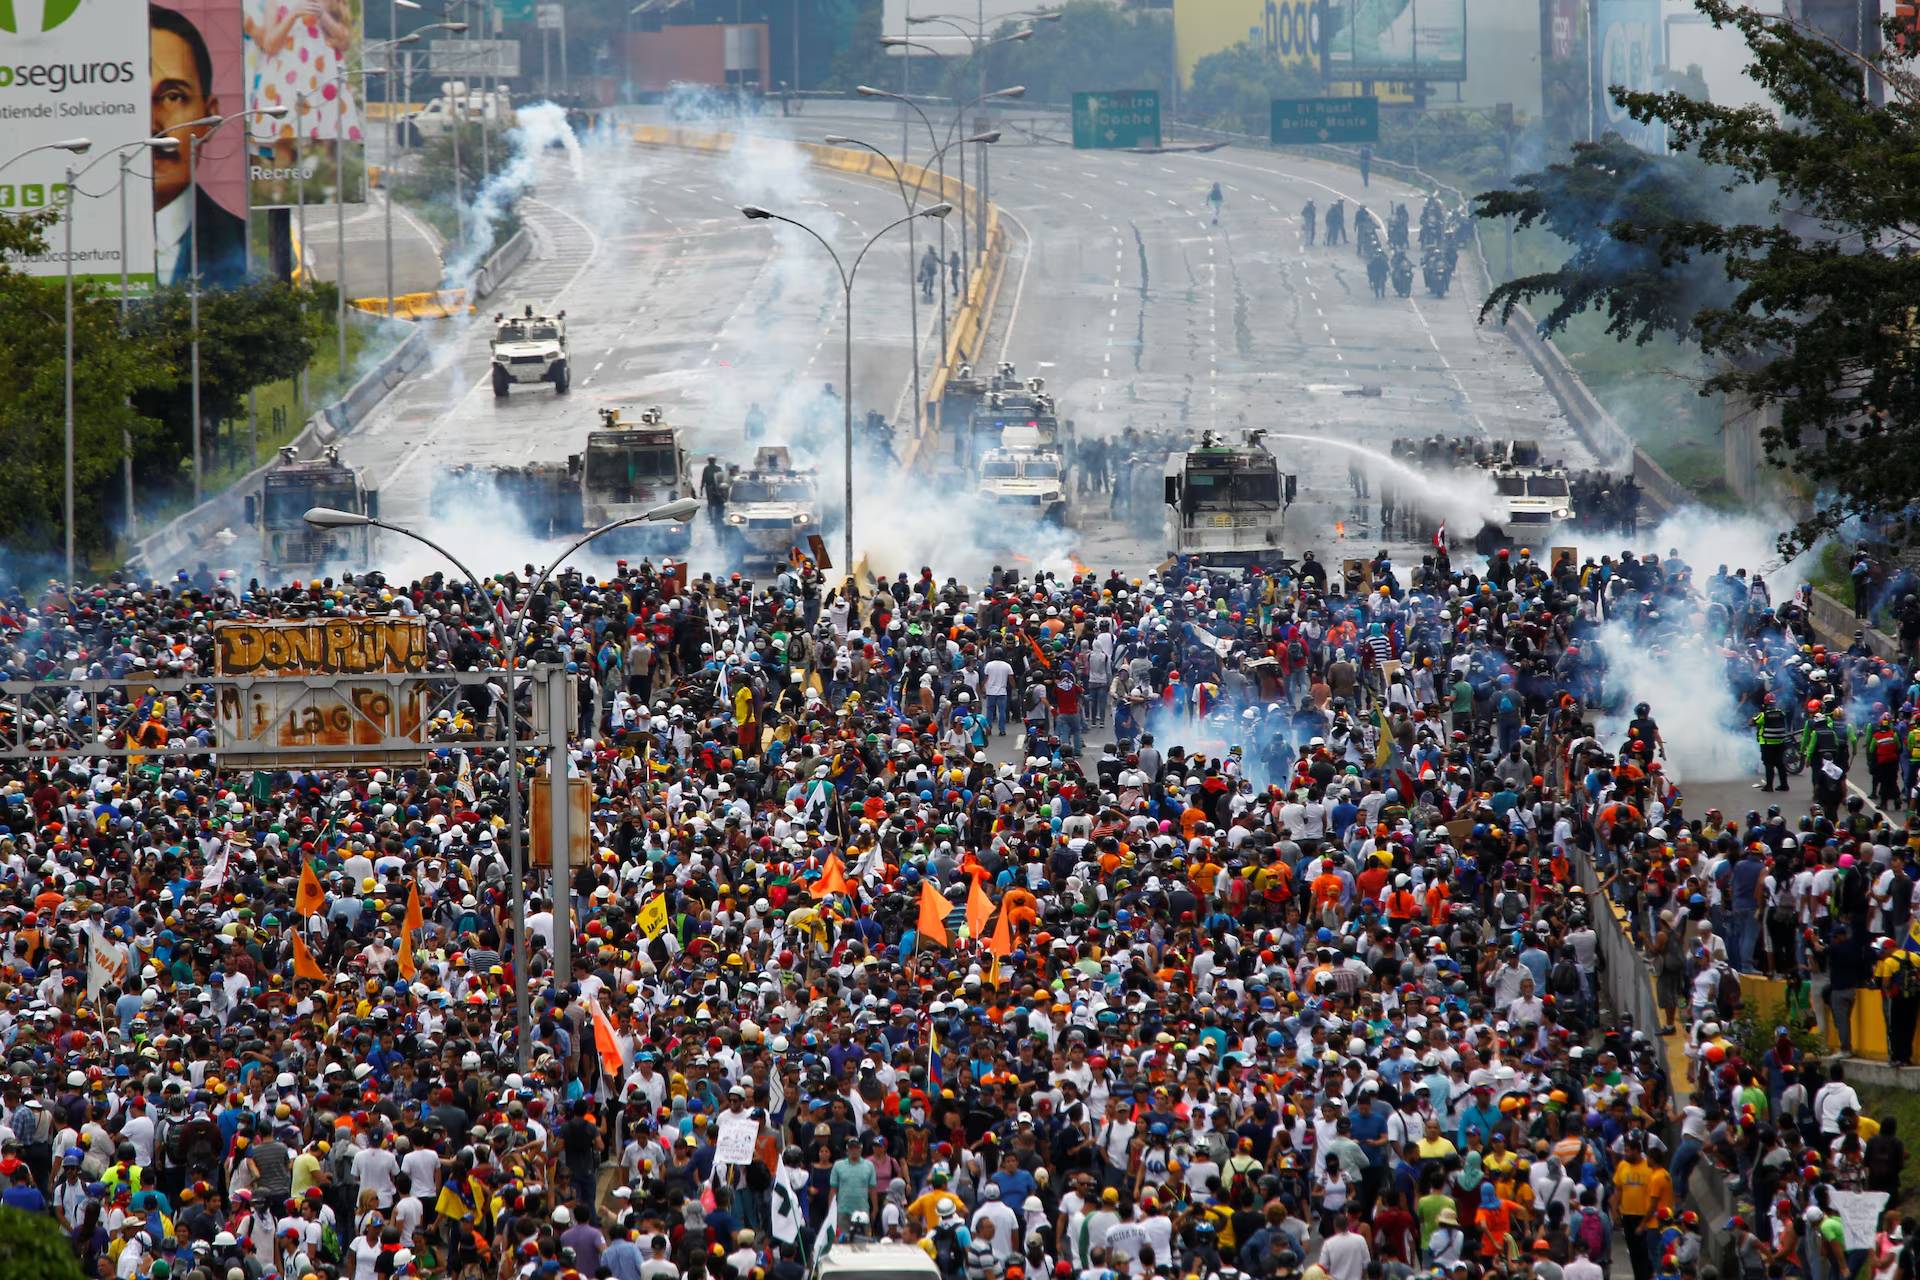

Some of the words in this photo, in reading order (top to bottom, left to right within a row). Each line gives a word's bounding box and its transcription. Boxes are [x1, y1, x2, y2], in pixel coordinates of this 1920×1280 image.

[0, 103, 53, 119] tiende
[60, 101, 136, 117] Soluciona
[250, 165, 314, 181] Recreo
[217, 625, 323, 674] DON
